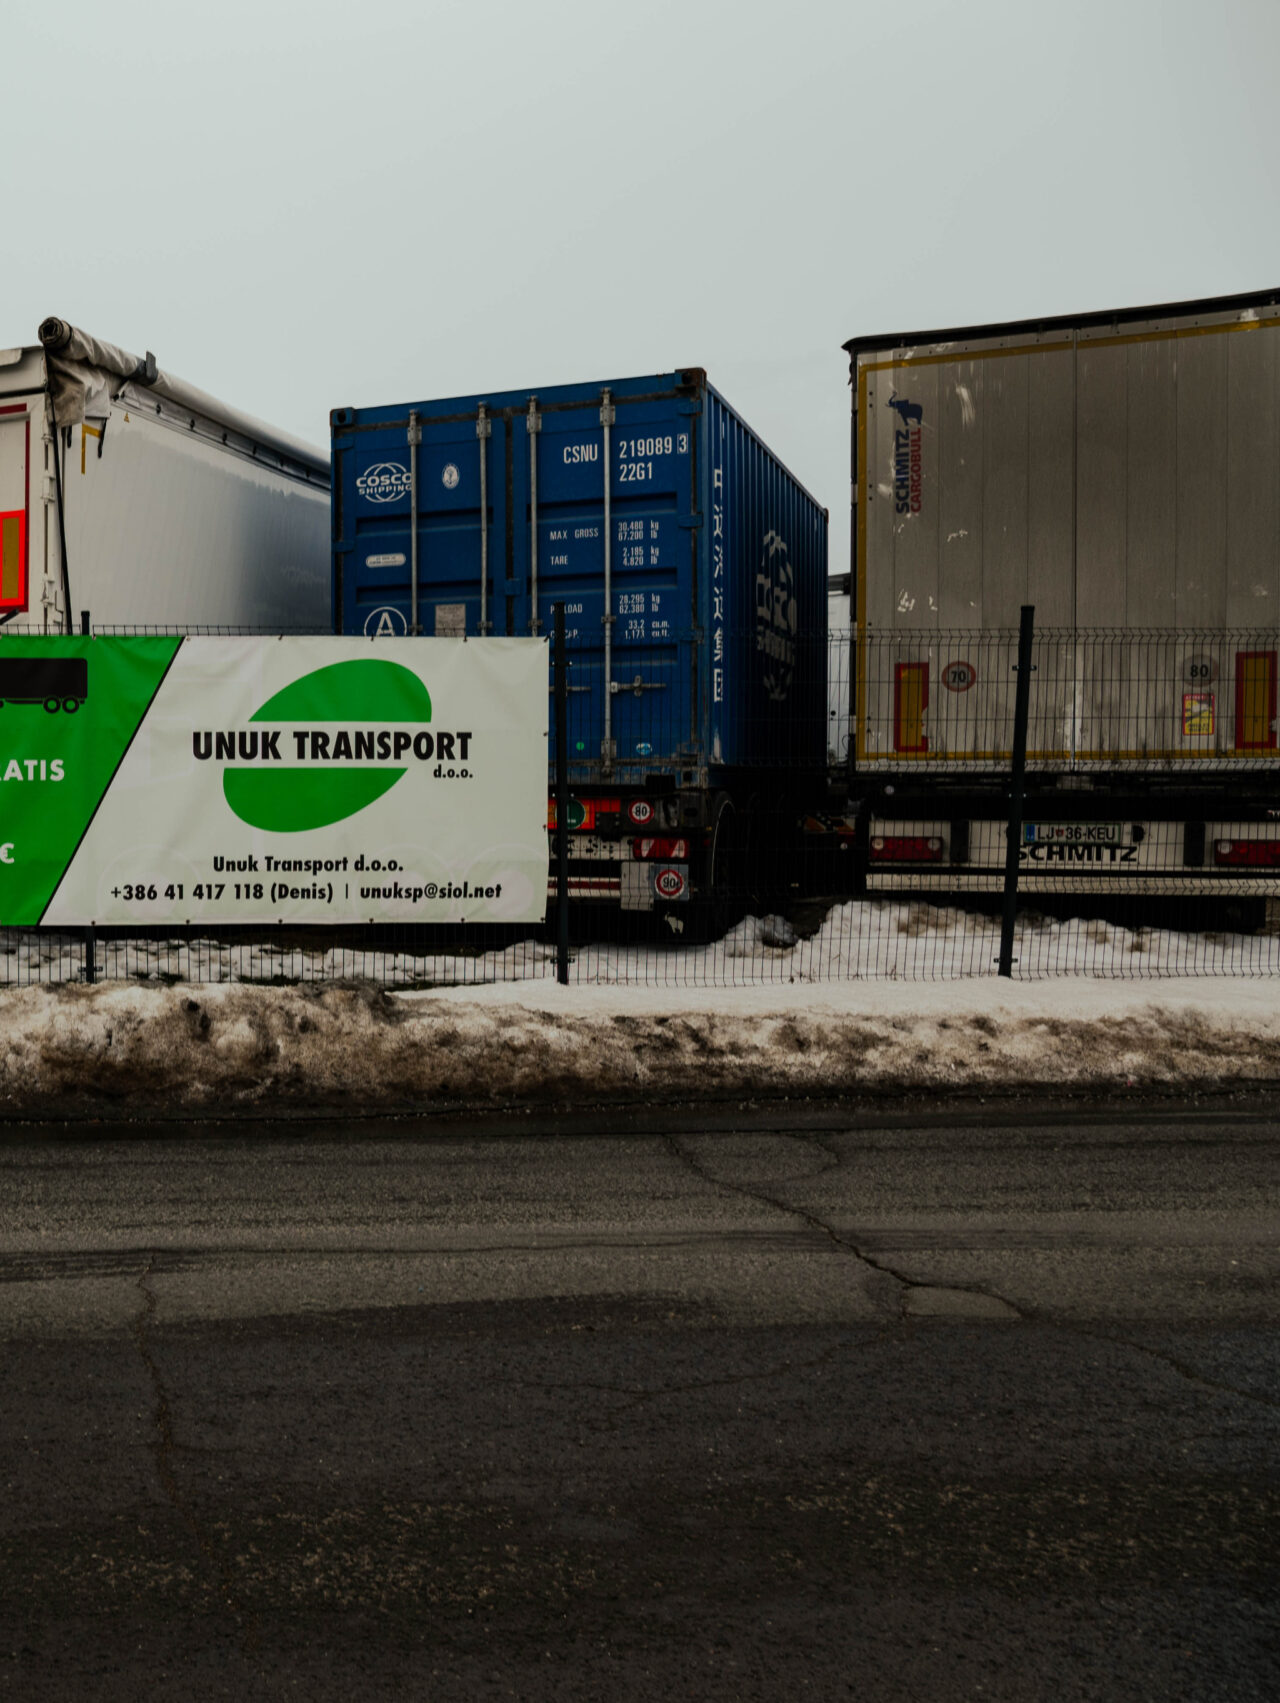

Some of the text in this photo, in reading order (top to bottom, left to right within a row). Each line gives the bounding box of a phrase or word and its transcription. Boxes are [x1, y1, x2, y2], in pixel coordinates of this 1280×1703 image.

[563, 443, 598, 464] CSNU
[619, 436, 672, 459] 219089
[619, 461, 652, 481] 22G1
[896, 429, 909, 513] SCHMITZ
[911, 428, 921, 512] CARGOBULL
[356, 472, 411, 488] COSCO
[358, 483, 411, 495] SHIPPING
[550, 530, 567, 541] MAX
[574, 528, 599, 539] GROSS
[550, 555, 568, 566] TARE
[550, 603, 583, 614] PLOAD
[376, 611, 396, 636] A
[951, 671, 967, 683] 70
[1190, 664, 1209, 677] 80
[192, 731, 472, 761] UNUK TRANSPORT
[433, 764, 473, 779] d.o.o.
[635, 805, 648, 817] 80
[1037, 826, 1055, 840] LJ
[213, 854, 404, 876] Unuk Transport d.o.o.
[111, 883, 158, 901] +386
[164, 883, 184, 900] 41
[192, 883, 225, 900] 417
[234, 883, 263, 900] 118
[270, 882, 334, 904] (Denis)
[360, 881, 502, 903] unuksp@siol.net
